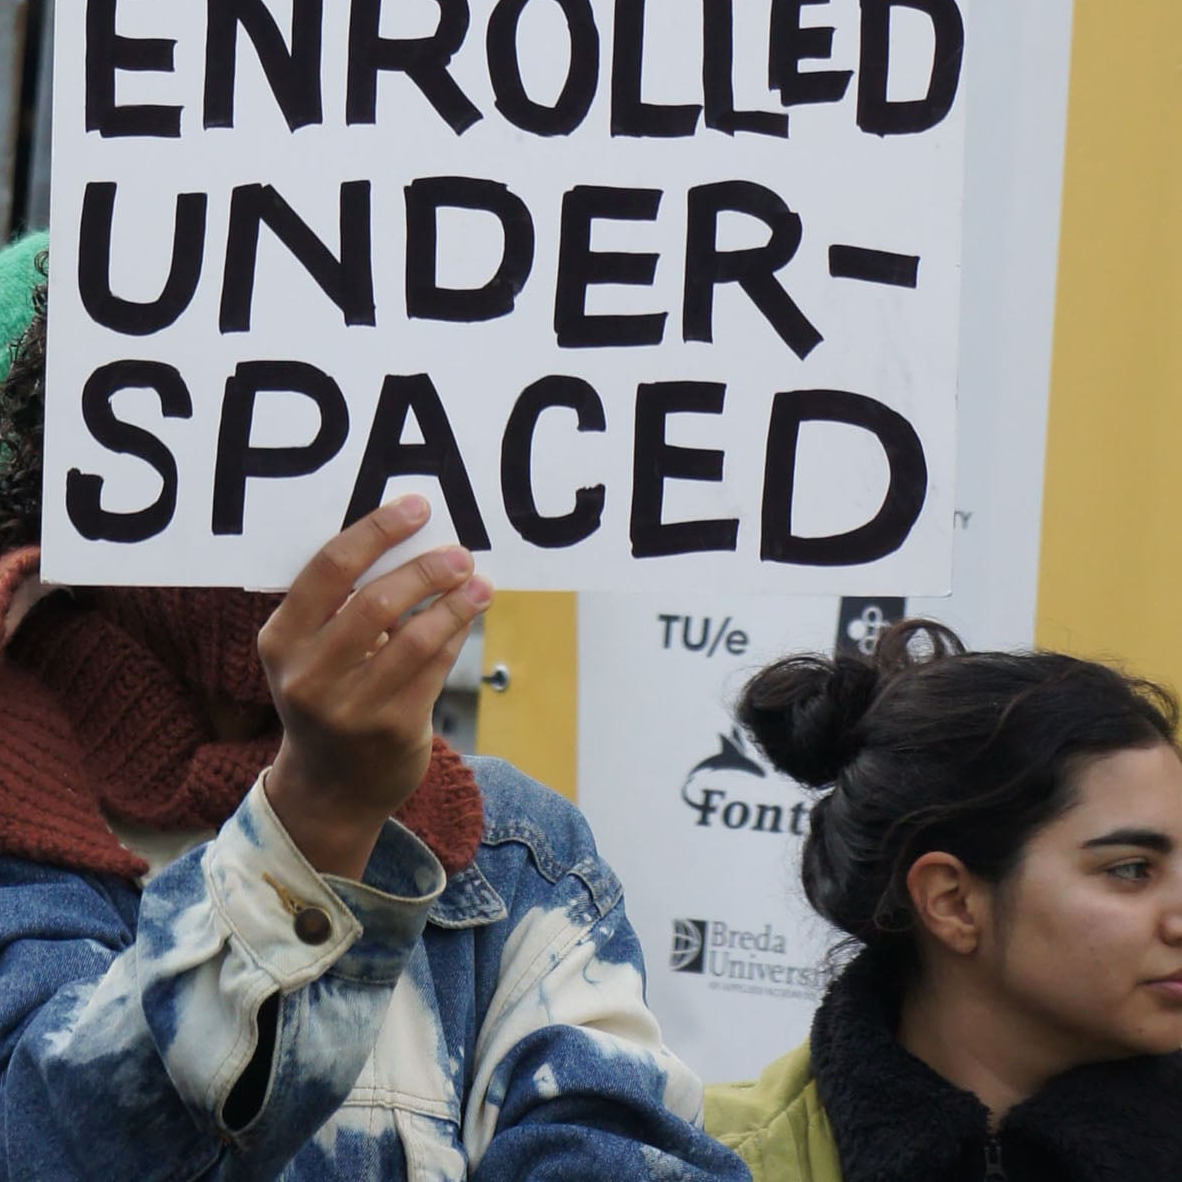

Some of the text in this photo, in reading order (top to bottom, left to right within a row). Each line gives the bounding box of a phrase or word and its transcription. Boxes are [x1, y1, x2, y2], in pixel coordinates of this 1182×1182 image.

[77, 175, 920, 360] UNDER-
[66, 359, 928, 567] SPACED
[657, 613, 750, 657] TU/e
[711, 920, 786, 954] Breda
